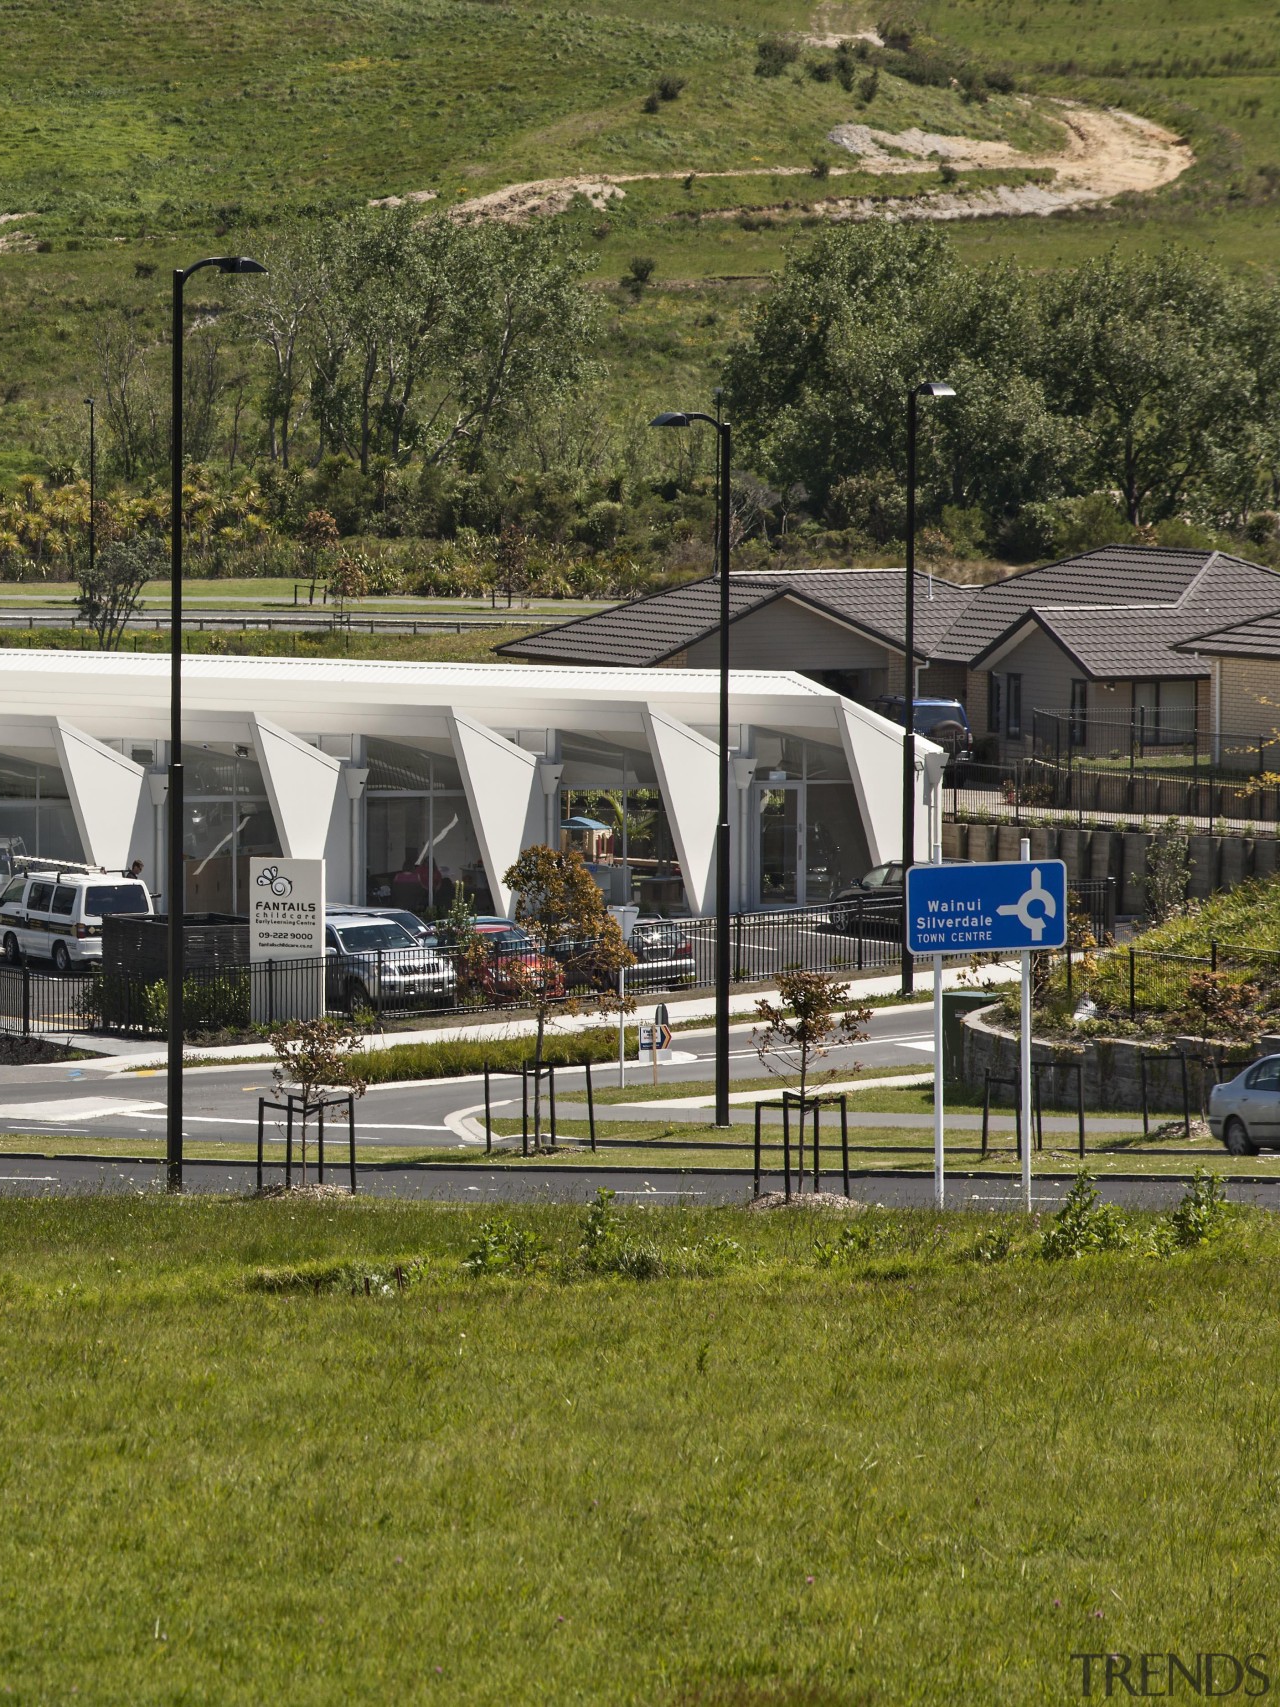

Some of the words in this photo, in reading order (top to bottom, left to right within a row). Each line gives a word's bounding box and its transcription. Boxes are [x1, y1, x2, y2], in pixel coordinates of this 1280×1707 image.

[255, 901, 316, 912] FANTAILS
[927, 898, 981, 913] Wainui
[255, 912, 316, 920] childcare
[916, 915, 993, 930] Silverdale
[290, 932, 313, 940] 9000
[917, 933, 945, 943] TOWN
[951, 931, 993, 942] CENTRE
